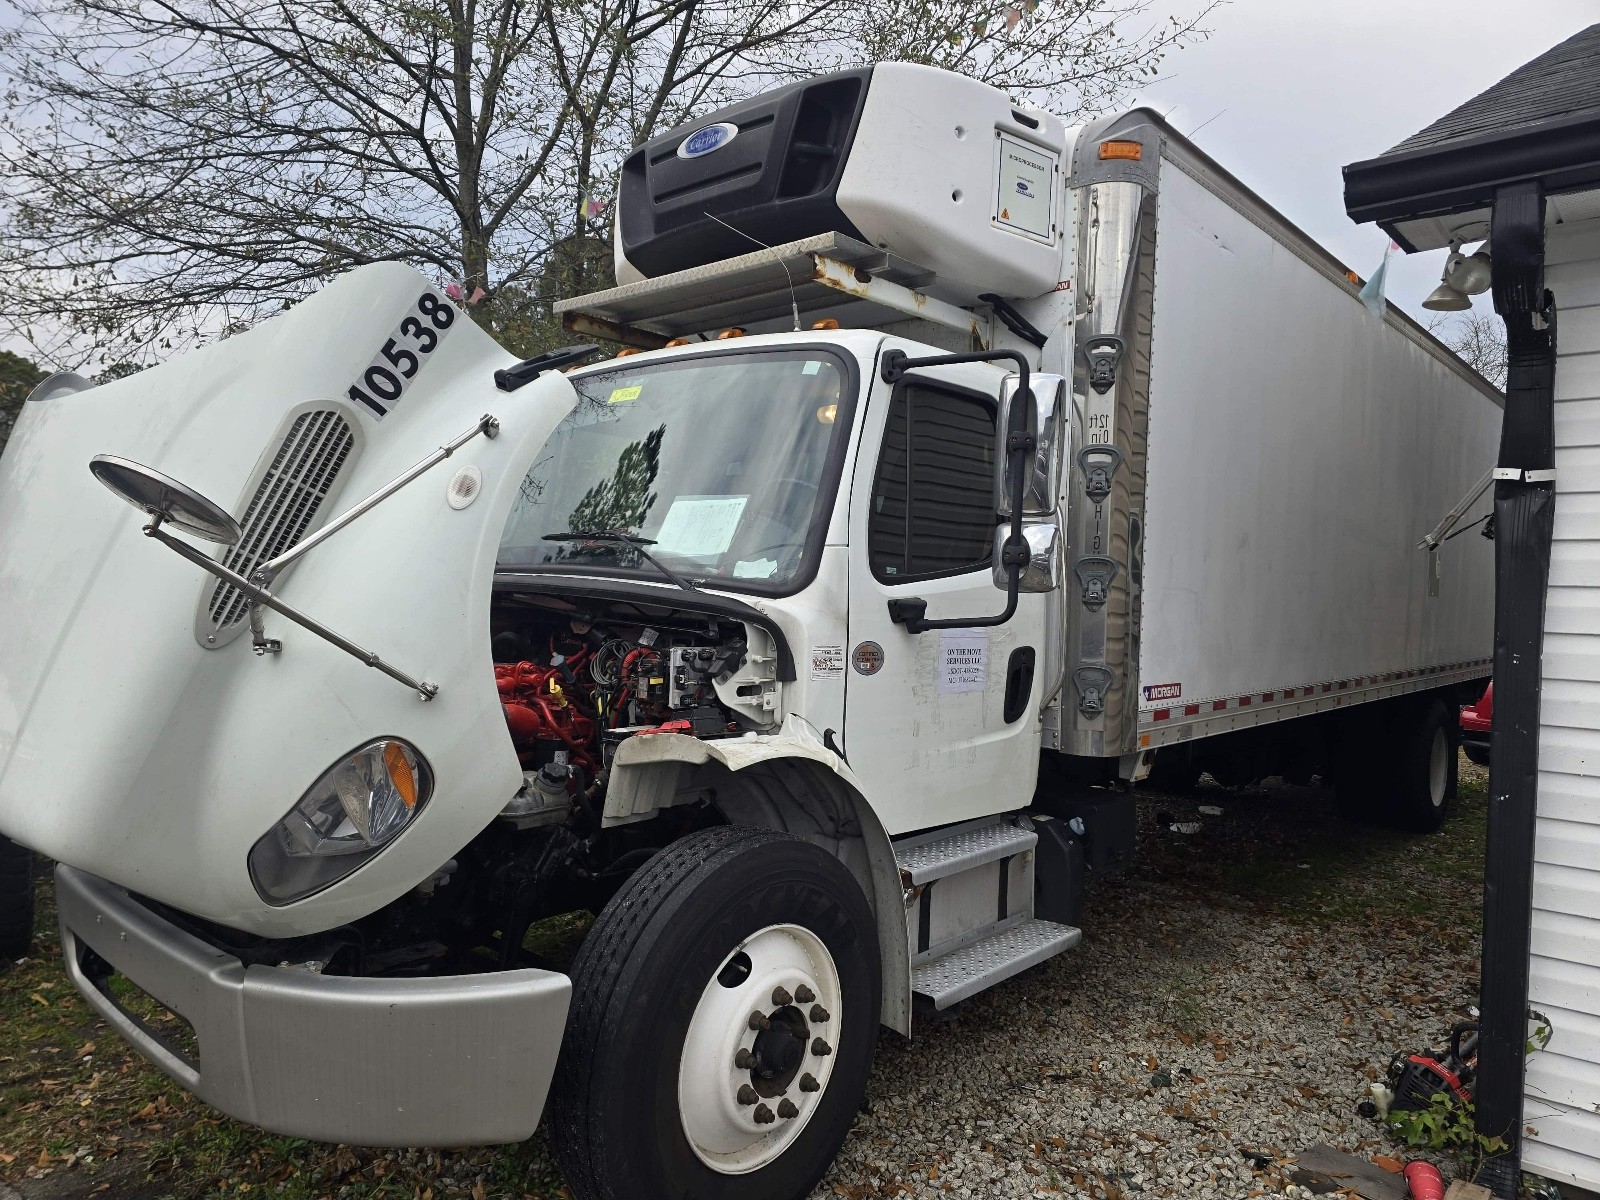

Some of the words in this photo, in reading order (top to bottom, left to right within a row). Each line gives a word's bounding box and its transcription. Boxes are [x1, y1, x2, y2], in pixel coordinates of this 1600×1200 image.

[690, 132, 722, 149] Carrier
[347, 292, 455, 417] 10538
[947, 648, 955, 656] ON
[956, 648, 966, 656] THE
[967, 648, 982, 656] MOVE
[946, 657, 970, 665] SERVICES
[971, 657, 982, 665] LLC
[1150, 685, 1181, 699] MORGAN
